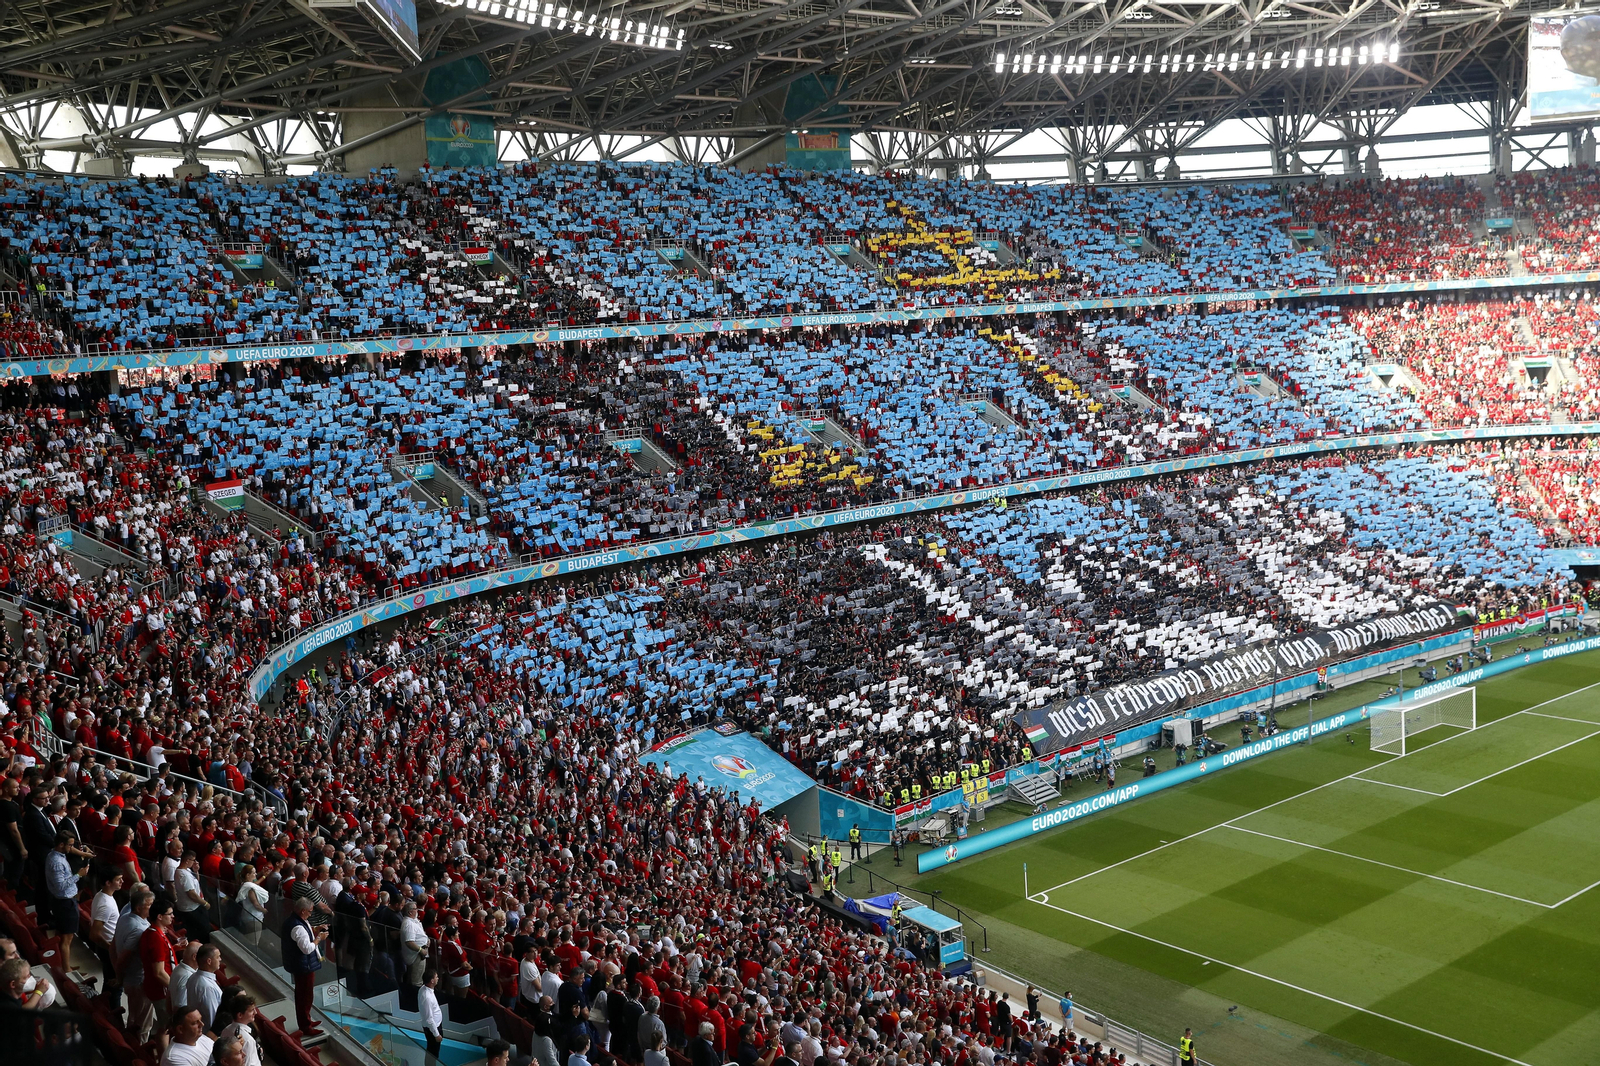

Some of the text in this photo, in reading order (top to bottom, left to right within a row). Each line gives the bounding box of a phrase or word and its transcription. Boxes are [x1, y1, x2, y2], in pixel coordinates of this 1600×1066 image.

[1205, 291, 1256, 302] UEFA EURO 2020
[1023, 303, 1056, 312] BUDAPEST
[801, 314, 857, 325] UEFA EURO 2020
[558, 329, 603, 341] BUDAPEST
[235, 345, 315, 360] UEFA EURO 2020
[1279, 445, 1310, 456] BUDAPEST
[1078, 469, 1131, 484] UEFA EURO 2020
[213, 489, 237, 498] SZEGED
[972, 487, 1009, 501] BUDAPEST
[833, 505, 896, 524] UEFA EURO 2020
[567, 552, 620, 572] BUDAPEST
[302, 620, 353, 655] UEFA EURO 2020
[1542, 636, 1600, 659] DOWNLOAD THE
[1413, 668, 1484, 700] EURO2020.COM/APP
[1222, 715, 1346, 766] DOWNLOAD THE OFFCIAL APP
[1032, 784, 1139, 832] EURO2020.COM/APP
